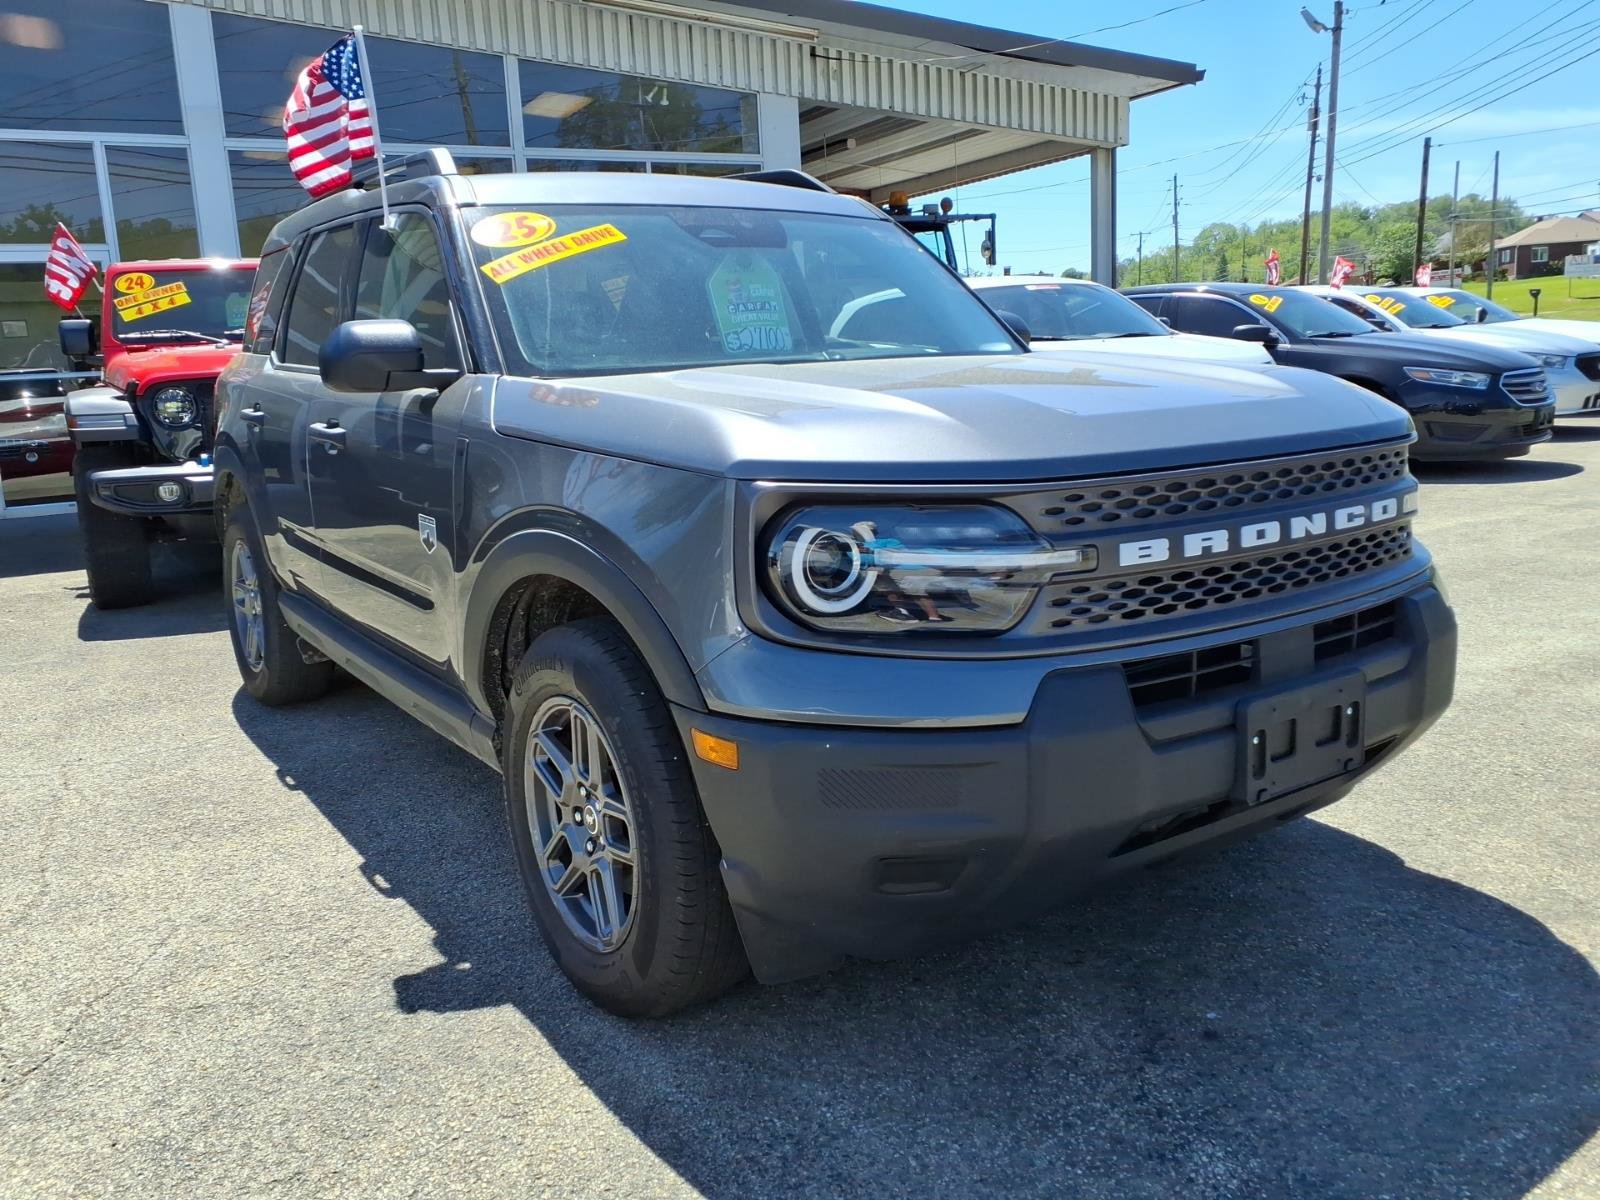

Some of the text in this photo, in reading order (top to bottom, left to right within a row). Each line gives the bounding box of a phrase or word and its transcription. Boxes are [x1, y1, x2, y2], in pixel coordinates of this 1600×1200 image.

[500, 215, 537, 241] 25
[490, 227, 617, 278] ALL WHEEL DRIVE
[116, 283, 183, 308] ONE OWNER
[124, 275, 145, 291] 24
[135, 306, 144, 315] 4
[167, 297, 176, 306] 4
[728, 300, 778, 313] CARFAX
[1119, 498, 1397, 566] BRONCO
